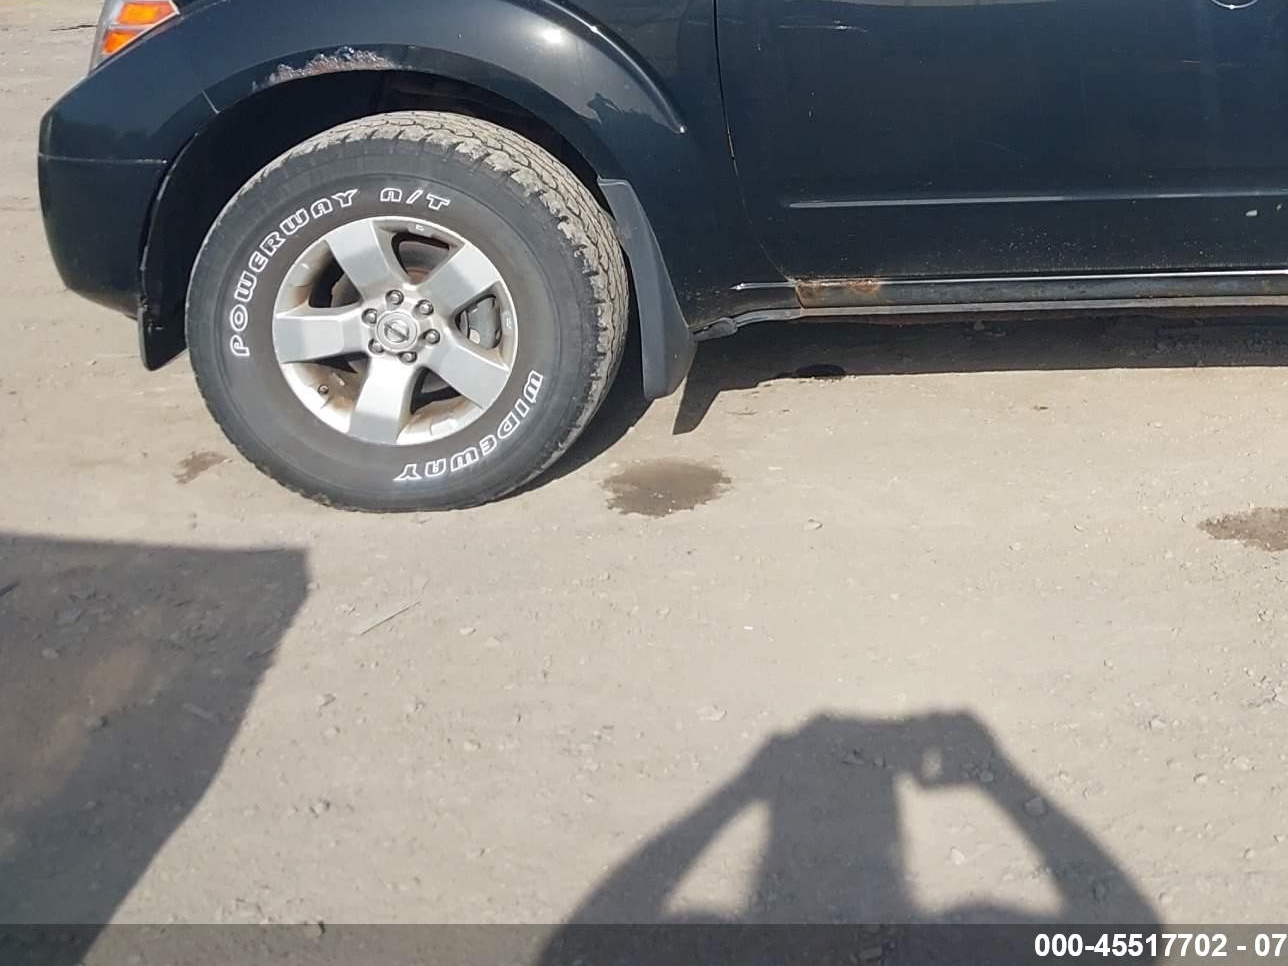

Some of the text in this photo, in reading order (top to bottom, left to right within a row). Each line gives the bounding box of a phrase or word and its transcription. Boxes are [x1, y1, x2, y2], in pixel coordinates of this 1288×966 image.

[230, 187, 450, 356] POWERWAY A/T
[393, 370, 544, 481] WIDEWAY
